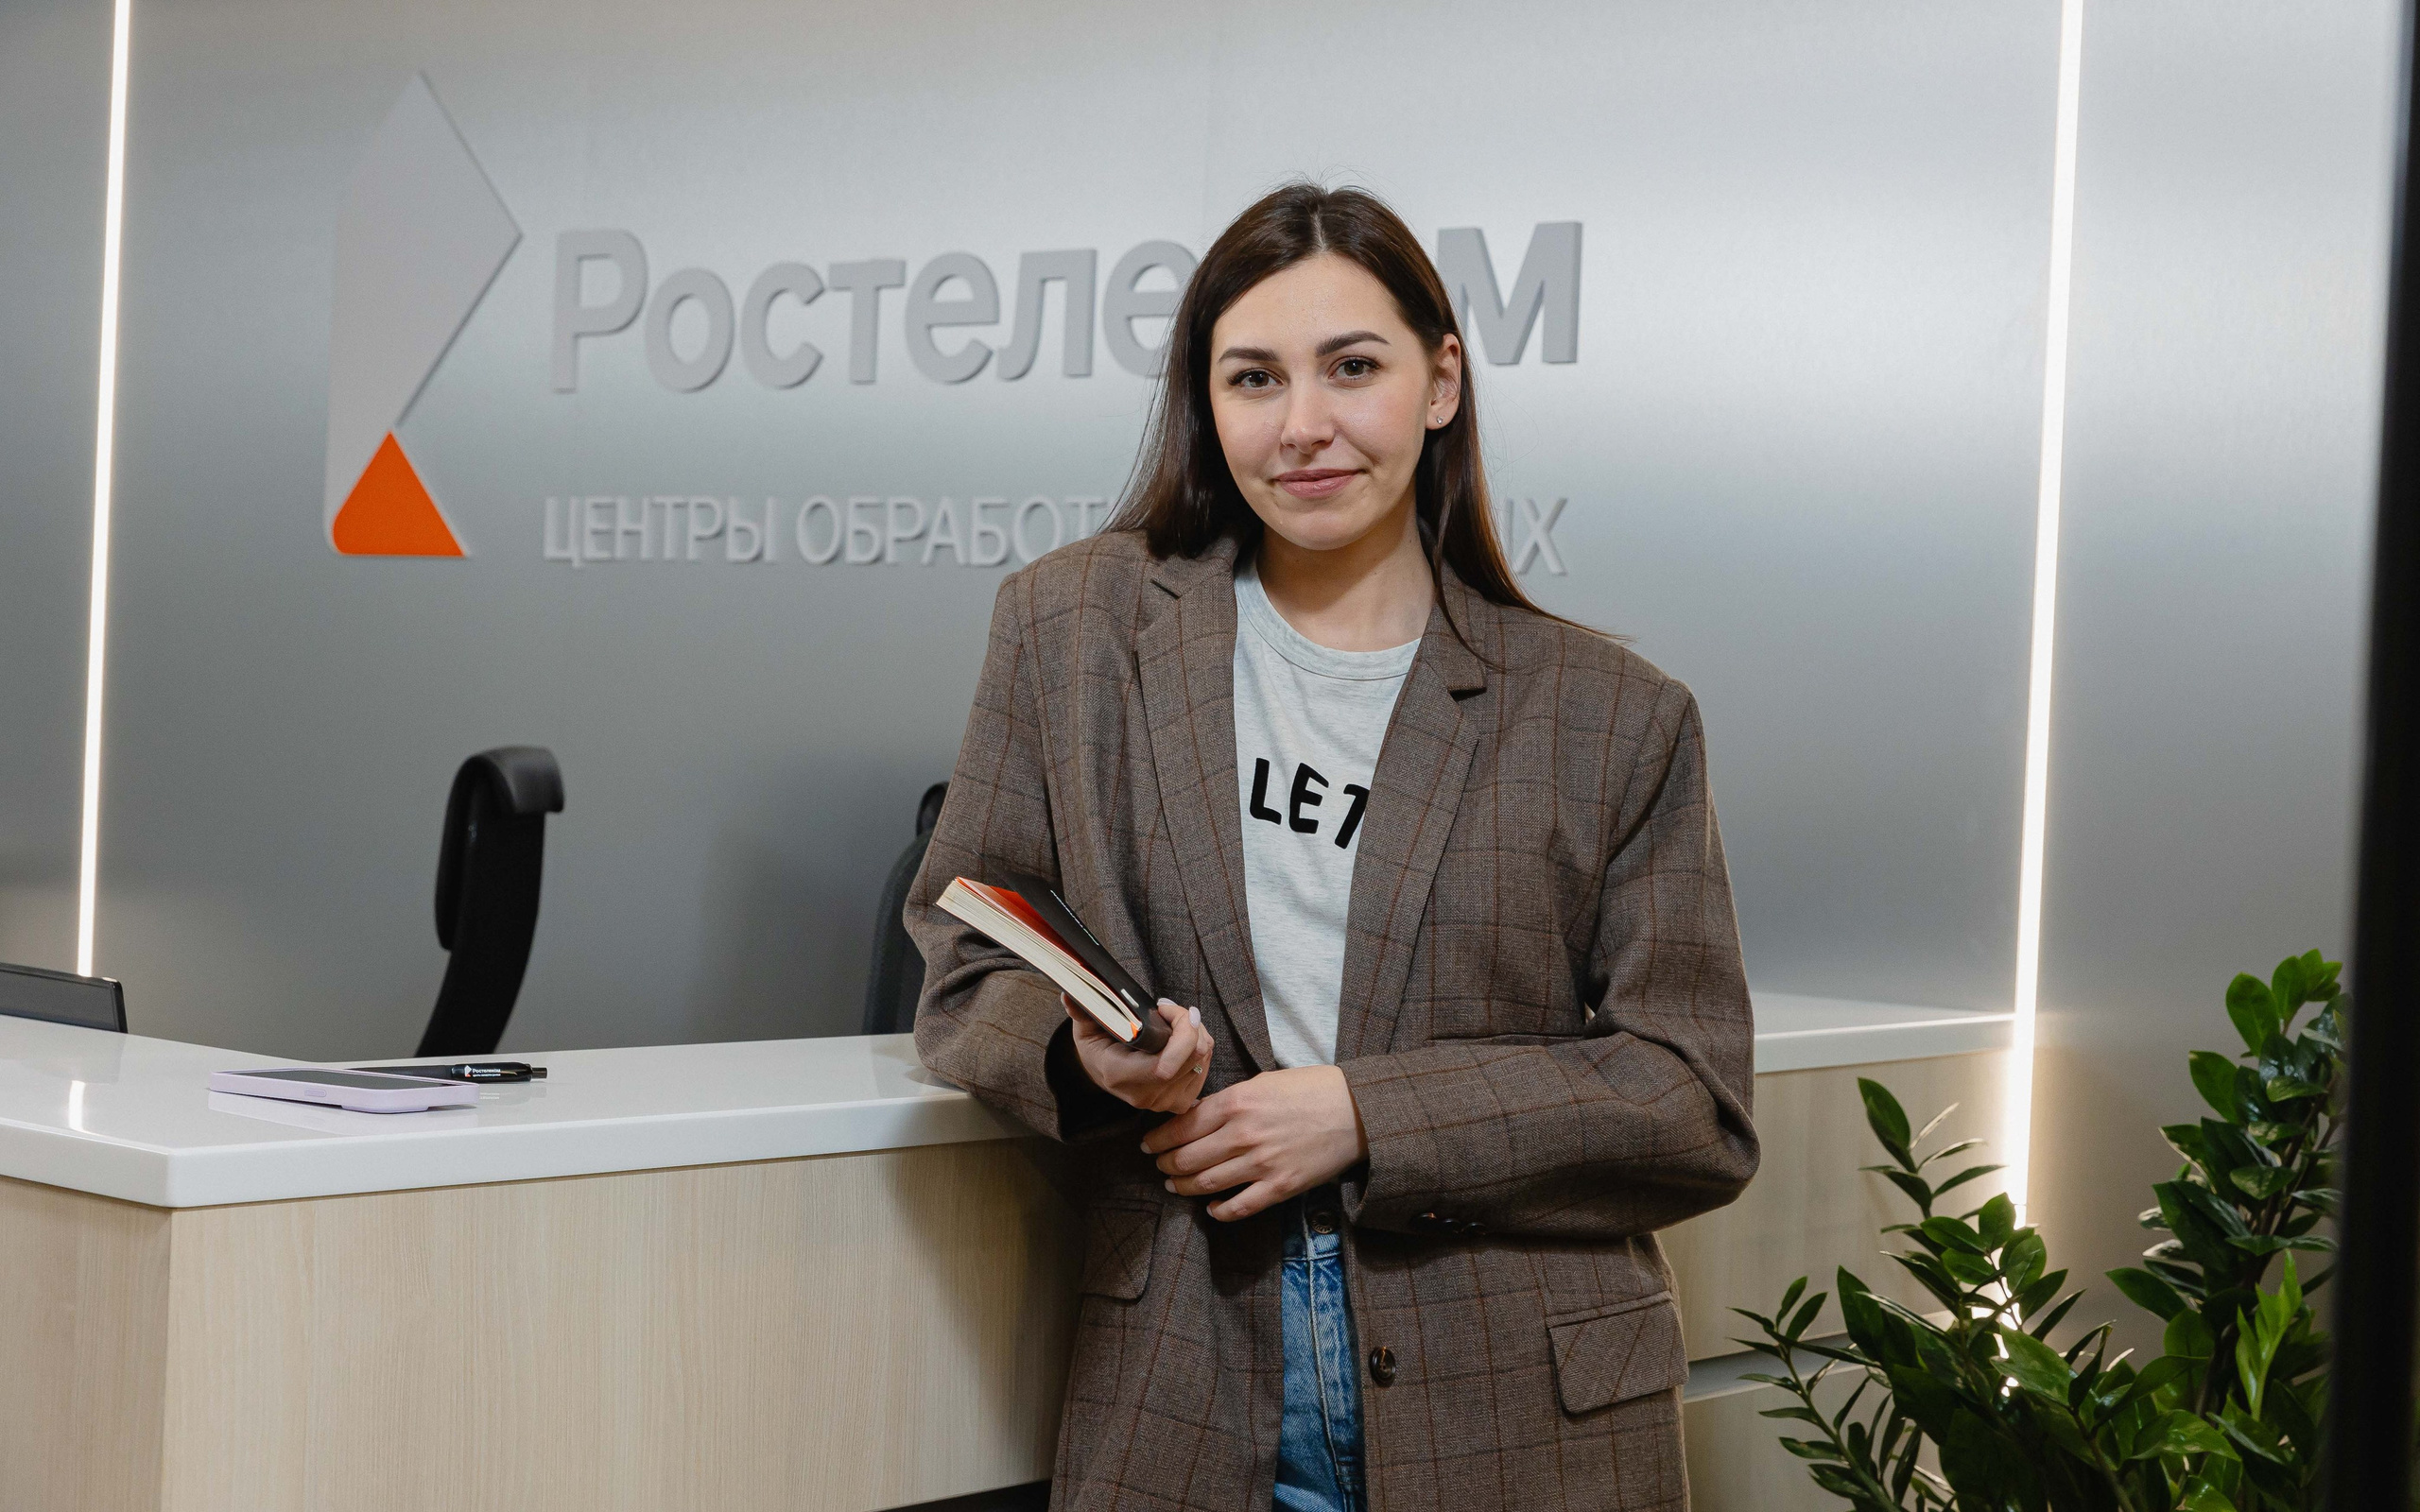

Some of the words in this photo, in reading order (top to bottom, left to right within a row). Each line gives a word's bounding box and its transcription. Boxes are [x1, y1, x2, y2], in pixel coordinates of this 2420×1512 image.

[552, 221, 1583, 393] Ростелем
[544, 496, 778, 567] ЦЕНТРЫ
[796, 496, 1117, 566] ОБРАБОТ
